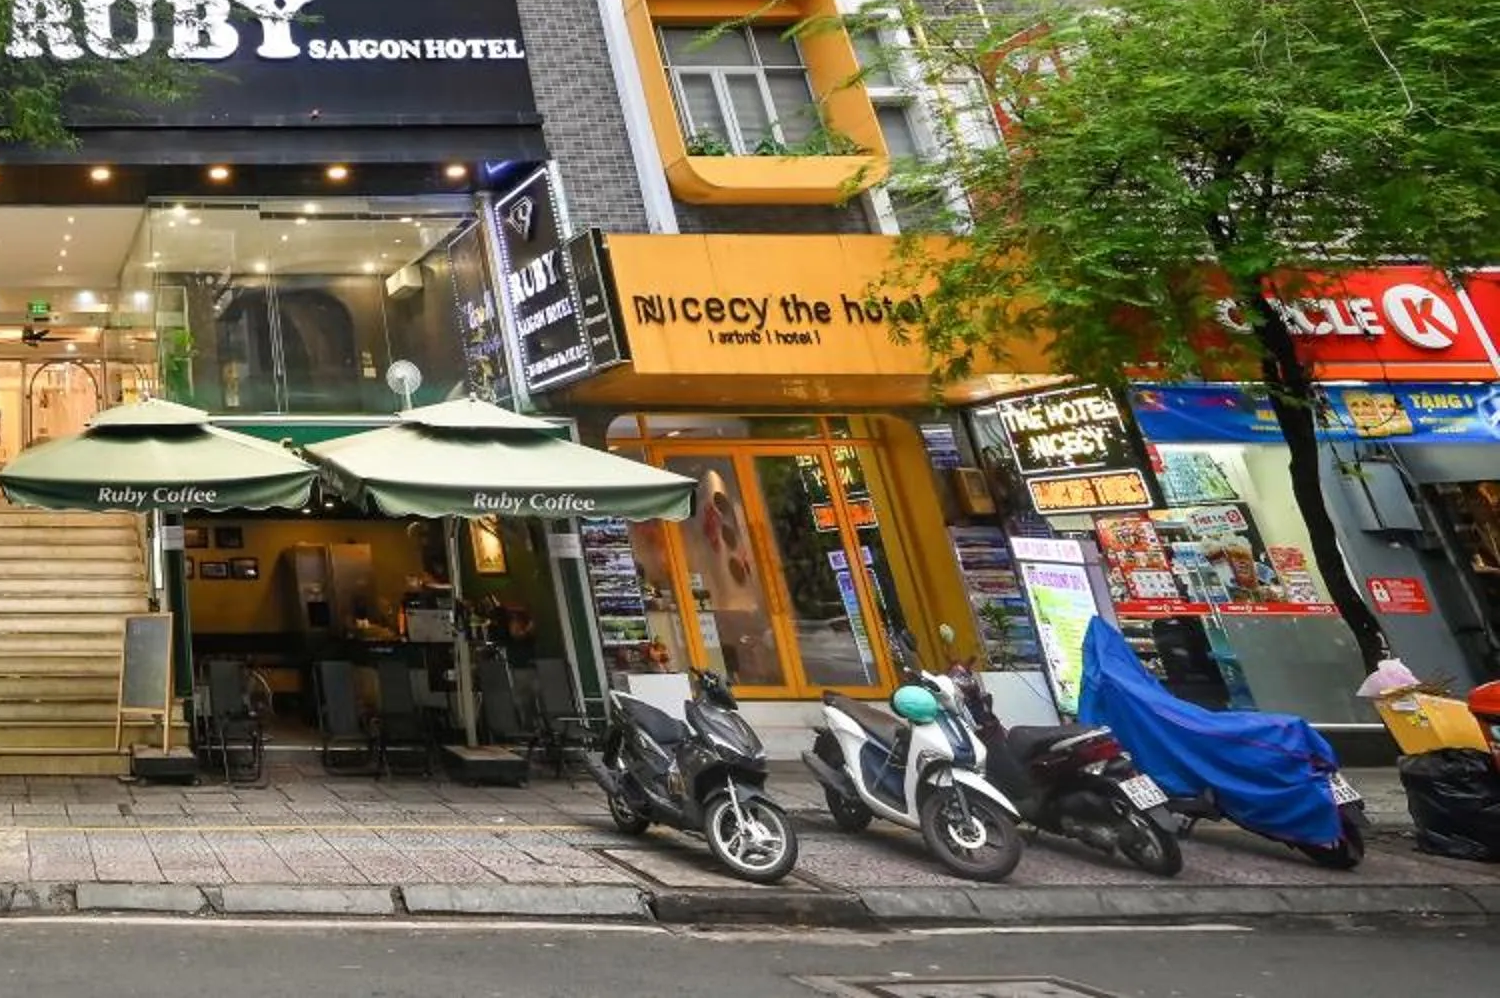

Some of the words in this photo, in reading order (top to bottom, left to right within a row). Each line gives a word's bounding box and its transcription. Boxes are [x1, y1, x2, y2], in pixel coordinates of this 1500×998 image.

[308, 39, 422, 60] SAIGON
[426, 38, 526, 60] HOTEL
[510, 249, 558, 304] RUBY
[780, 293, 832, 323] the
[1002, 404, 1047, 432] THE
[1046, 396, 1118, 426] HOTEL
[98, 485, 148, 506] Ruby
[153, 486, 217, 503] Coffee
[473, 491, 524, 514] Ruby
[529, 493, 596, 511] Coffee
